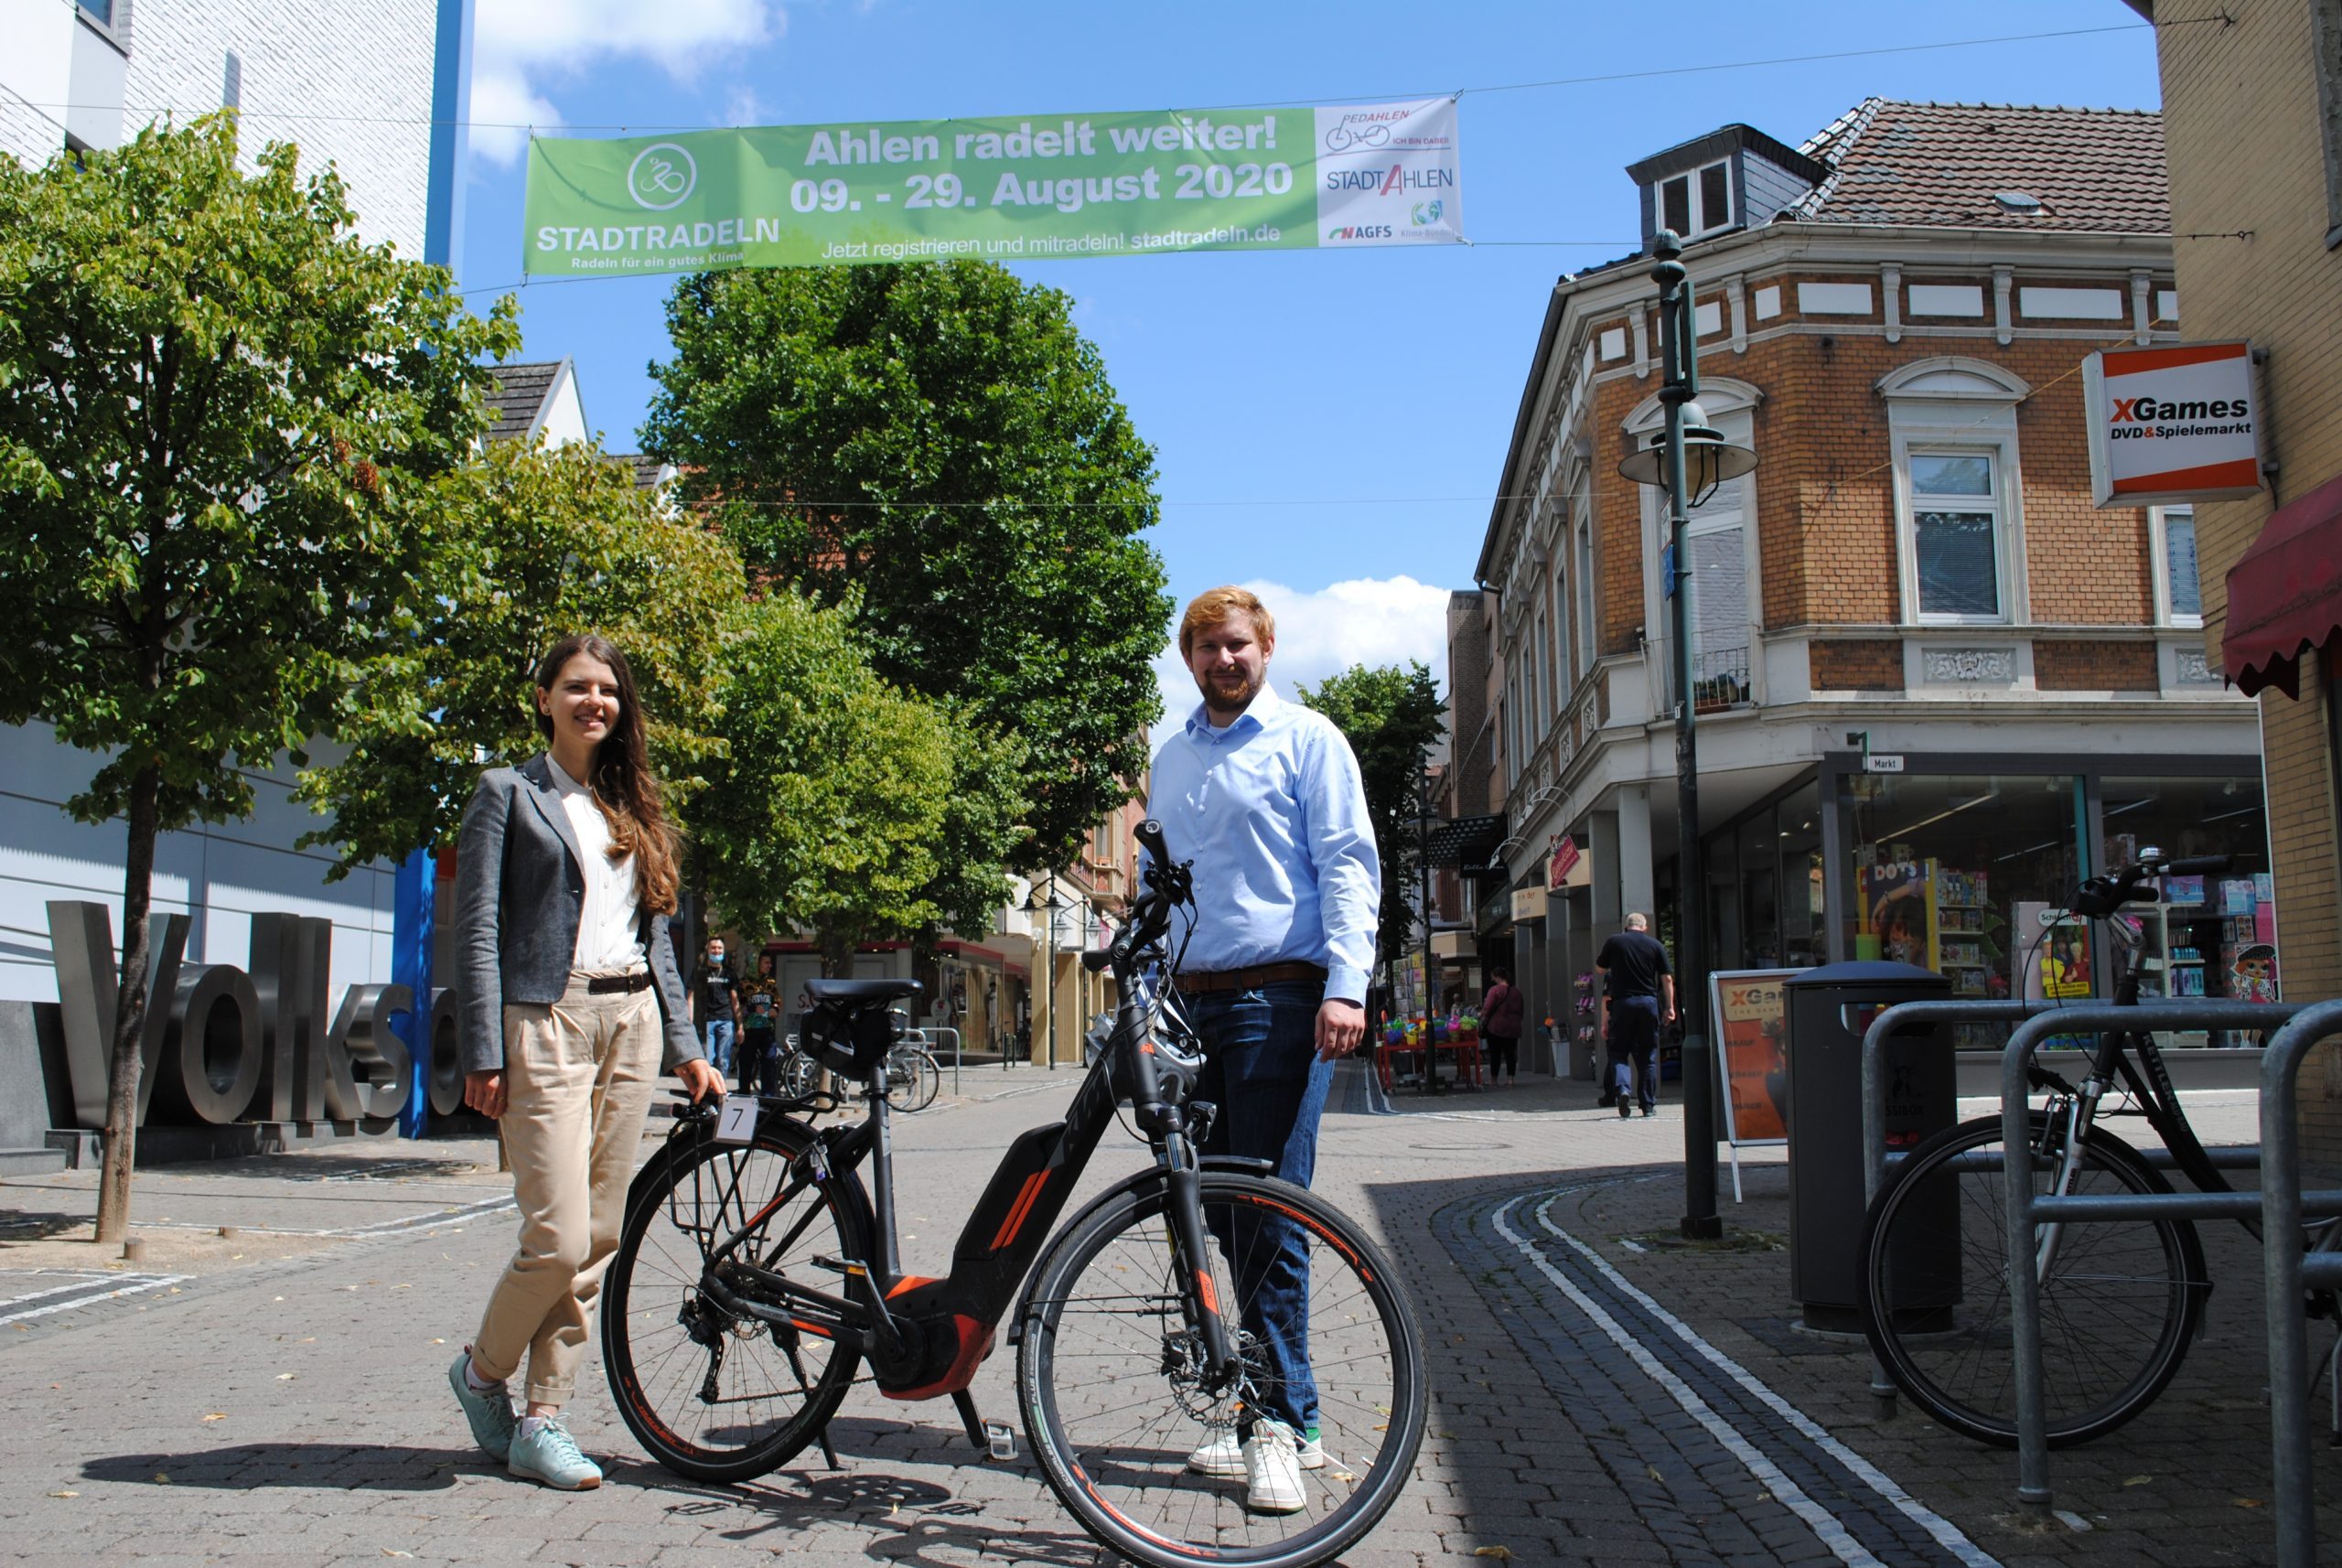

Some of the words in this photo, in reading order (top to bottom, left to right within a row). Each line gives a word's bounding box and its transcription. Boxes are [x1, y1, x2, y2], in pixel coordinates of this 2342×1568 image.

[1342, 110, 1410, 124] PEDAHLEN
[804, 129, 940, 166] Ahlen
[955, 121, 1096, 159] radelt
[1109, 115, 1276, 154] weiter!
[1408, 137, 1422, 145] BIN
[790, 178, 861, 213] 09.
[876, 193, 891, 203] -
[905, 173, 976, 209] 29.
[991, 166, 1160, 213] August
[1175, 162, 1293, 199] 2020
[537, 218, 779, 252] STADTRADELN
[822, 242, 868, 259] Jetzt
[874, 238, 981, 260] registrieren
[987, 236, 1023, 252] und
[1029, 232, 1124, 253] mitradeln!
[1130, 224, 1281, 249] stadtradeln.de
[1355, 225, 1392, 239] AGFS
[571, 257, 618, 269] Radeln
[621, 255, 640, 268] für
[644, 255, 664, 267] ein
[669, 253, 704, 271] gutes
[709, 251, 744, 264] Klima
[2110, 397, 2248, 424] XGames
[2111, 423, 2251, 440] DVD&Spielemarkt
[1875, 758, 1896, 768] Markt
[731, 1108, 744, 1131] 7
